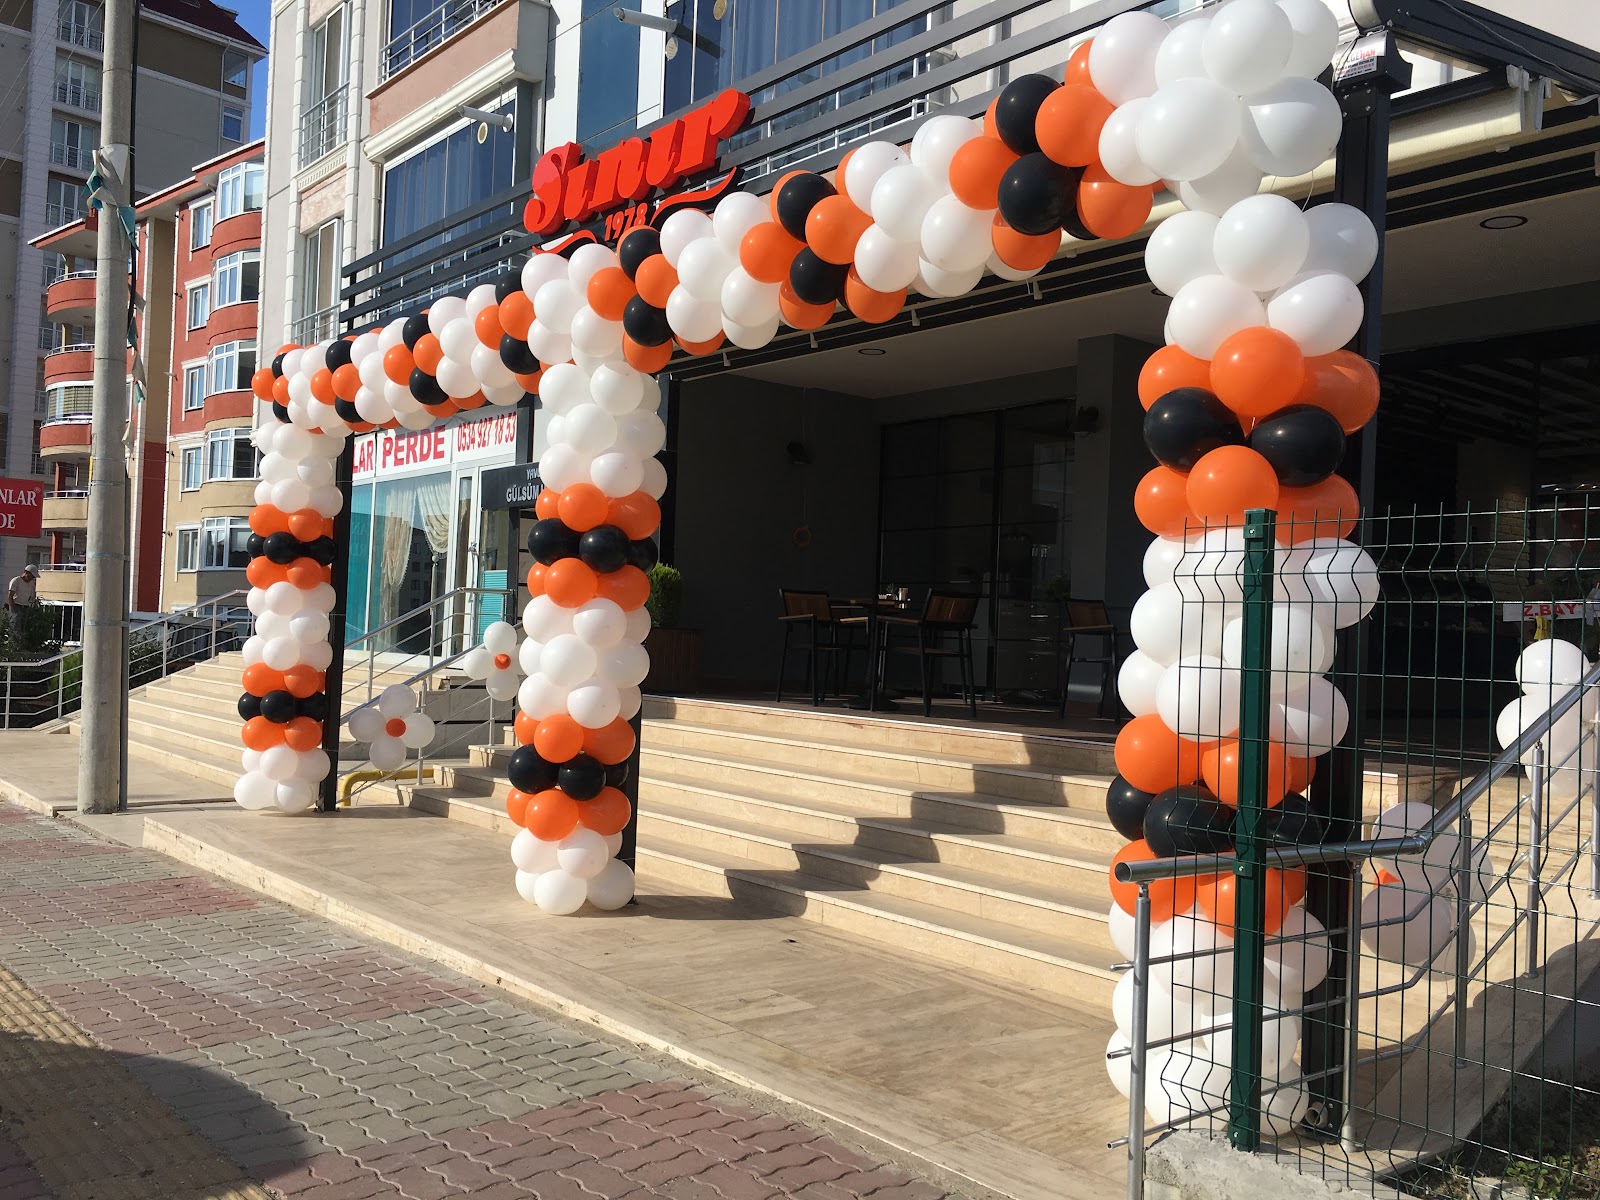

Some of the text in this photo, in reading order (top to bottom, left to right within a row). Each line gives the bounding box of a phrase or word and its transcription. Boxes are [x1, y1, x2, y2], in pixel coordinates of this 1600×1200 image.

[604, 202, 648, 241] 1978
[382, 425, 446, 468] PERDE
[457, 411, 517, 452] 0534 927 18 53
[506, 483, 539, 502] GÜLSÜM
